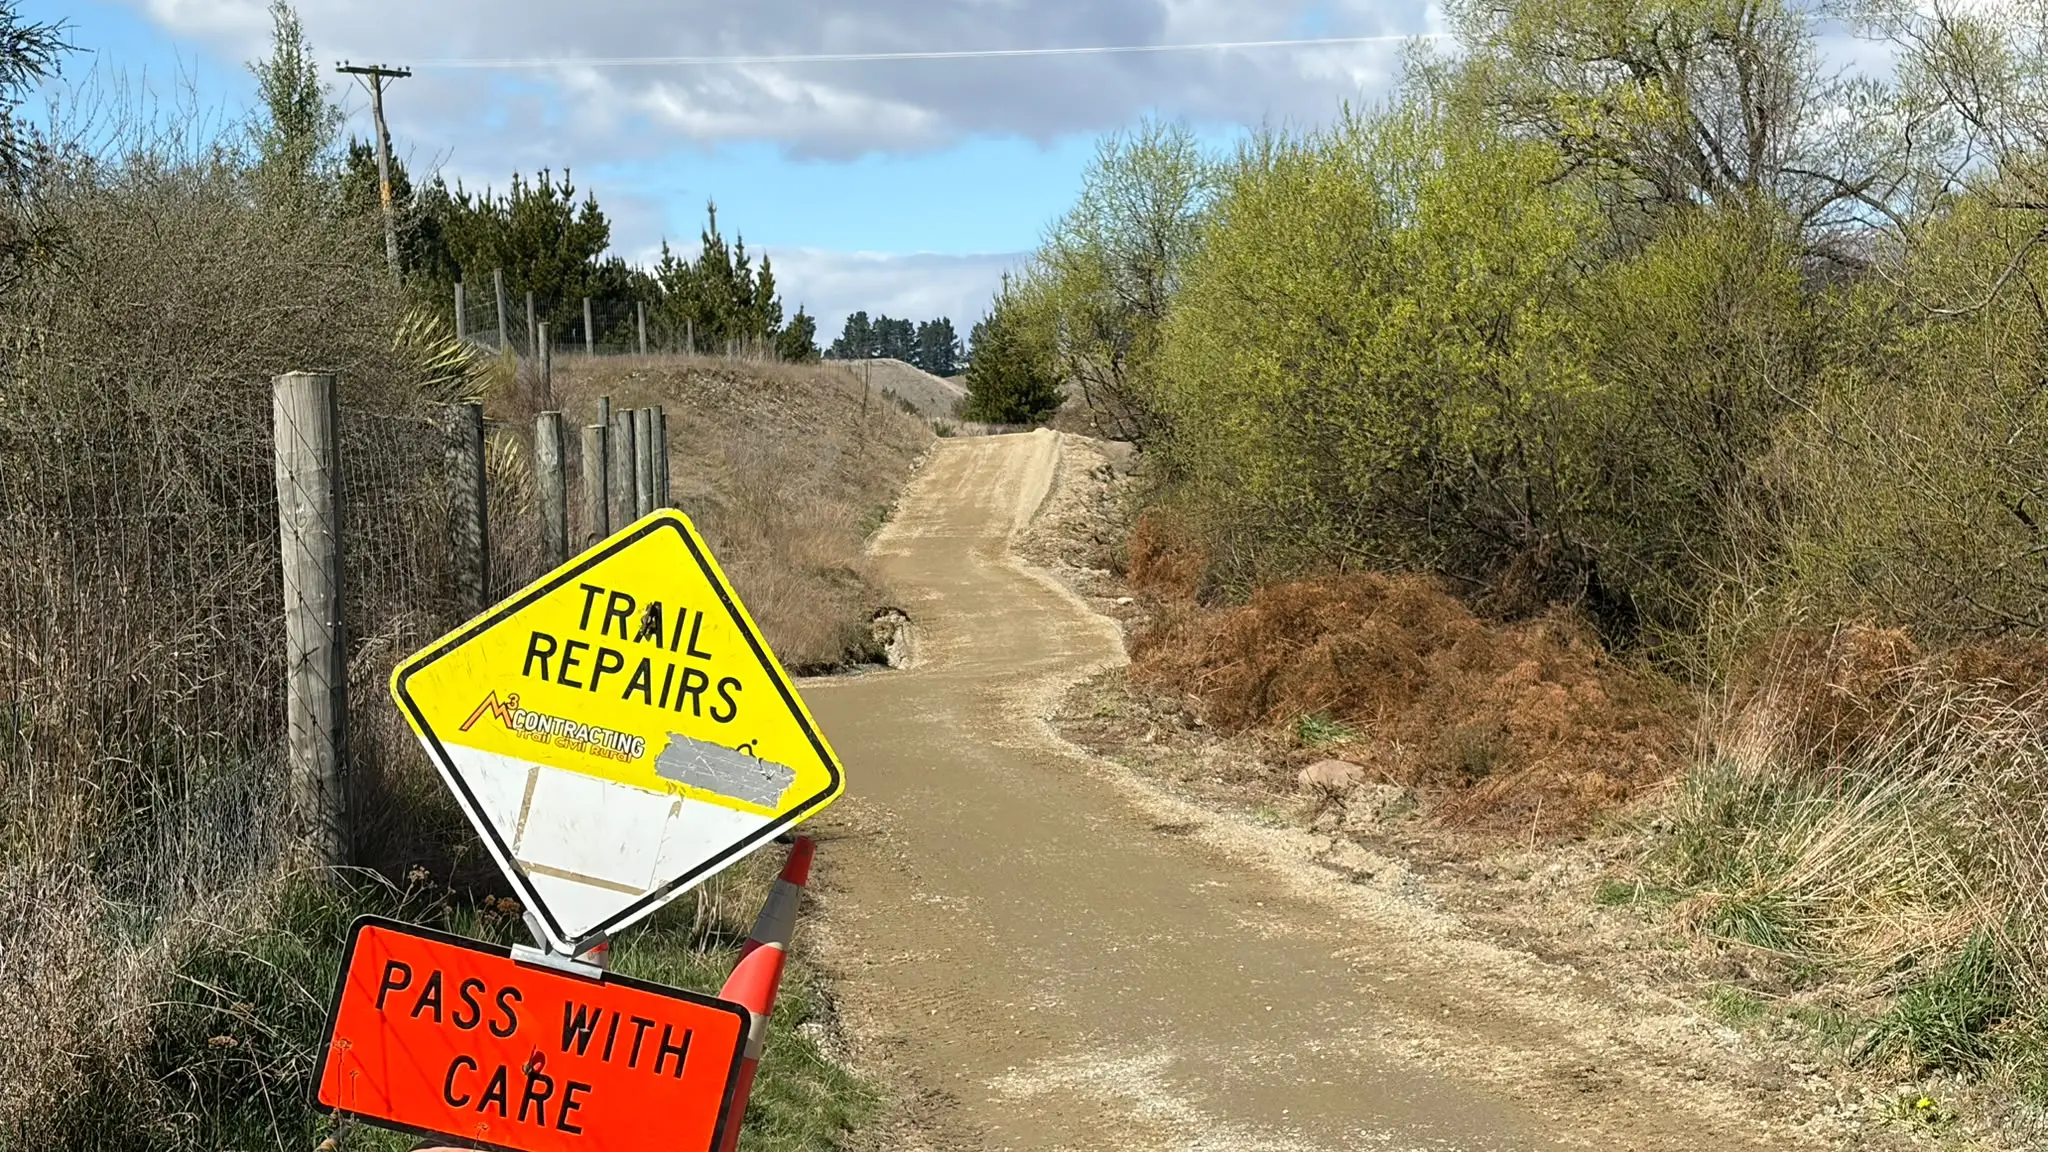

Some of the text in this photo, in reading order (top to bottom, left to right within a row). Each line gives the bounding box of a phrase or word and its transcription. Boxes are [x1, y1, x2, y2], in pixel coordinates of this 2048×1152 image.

[580, 583, 712, 661] TRAIL
[522, 631, 742, 724] REPAIRS
[512, 709, 646, 759] CONTRACTING
[516, 728, 633, 763] Trail Civil Rural
[375, 960, 693, 1079] PASS WITH
[444, 1055, 592, 1135] CARE
